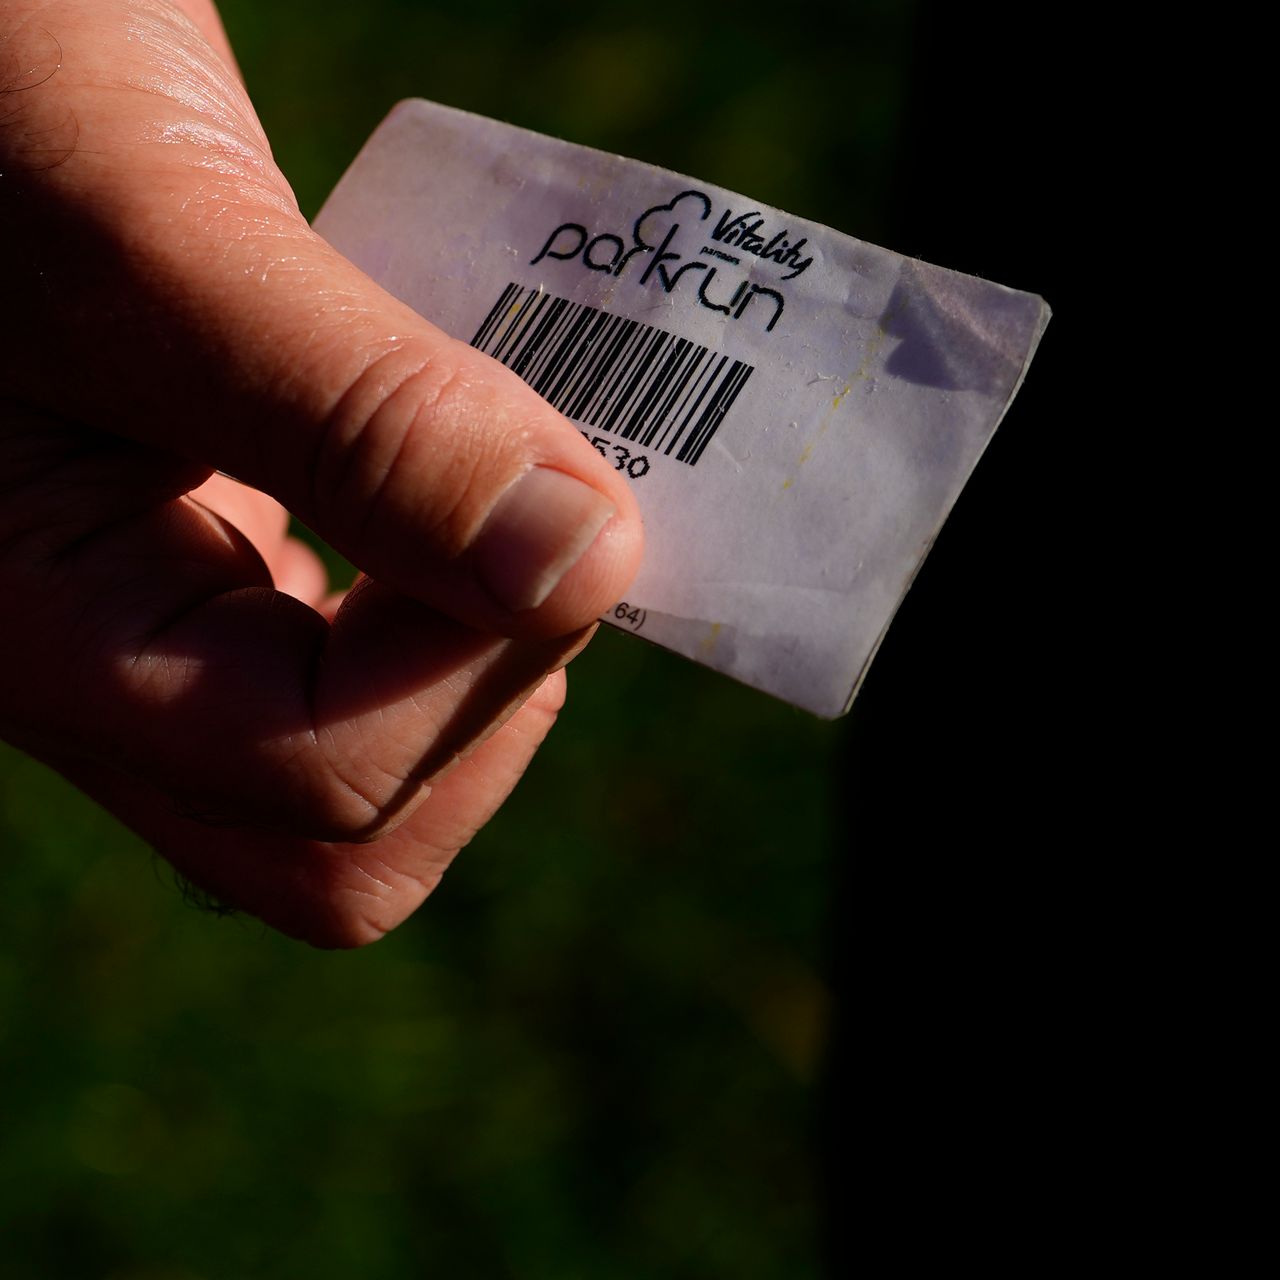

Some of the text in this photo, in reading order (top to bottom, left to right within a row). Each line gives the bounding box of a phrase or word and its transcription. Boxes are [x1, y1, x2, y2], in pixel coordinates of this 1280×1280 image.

[529, 222, 785, 332] parkrun
[711, 208, 814, 280] Vitality
[580, 430, 650, 479] 530
